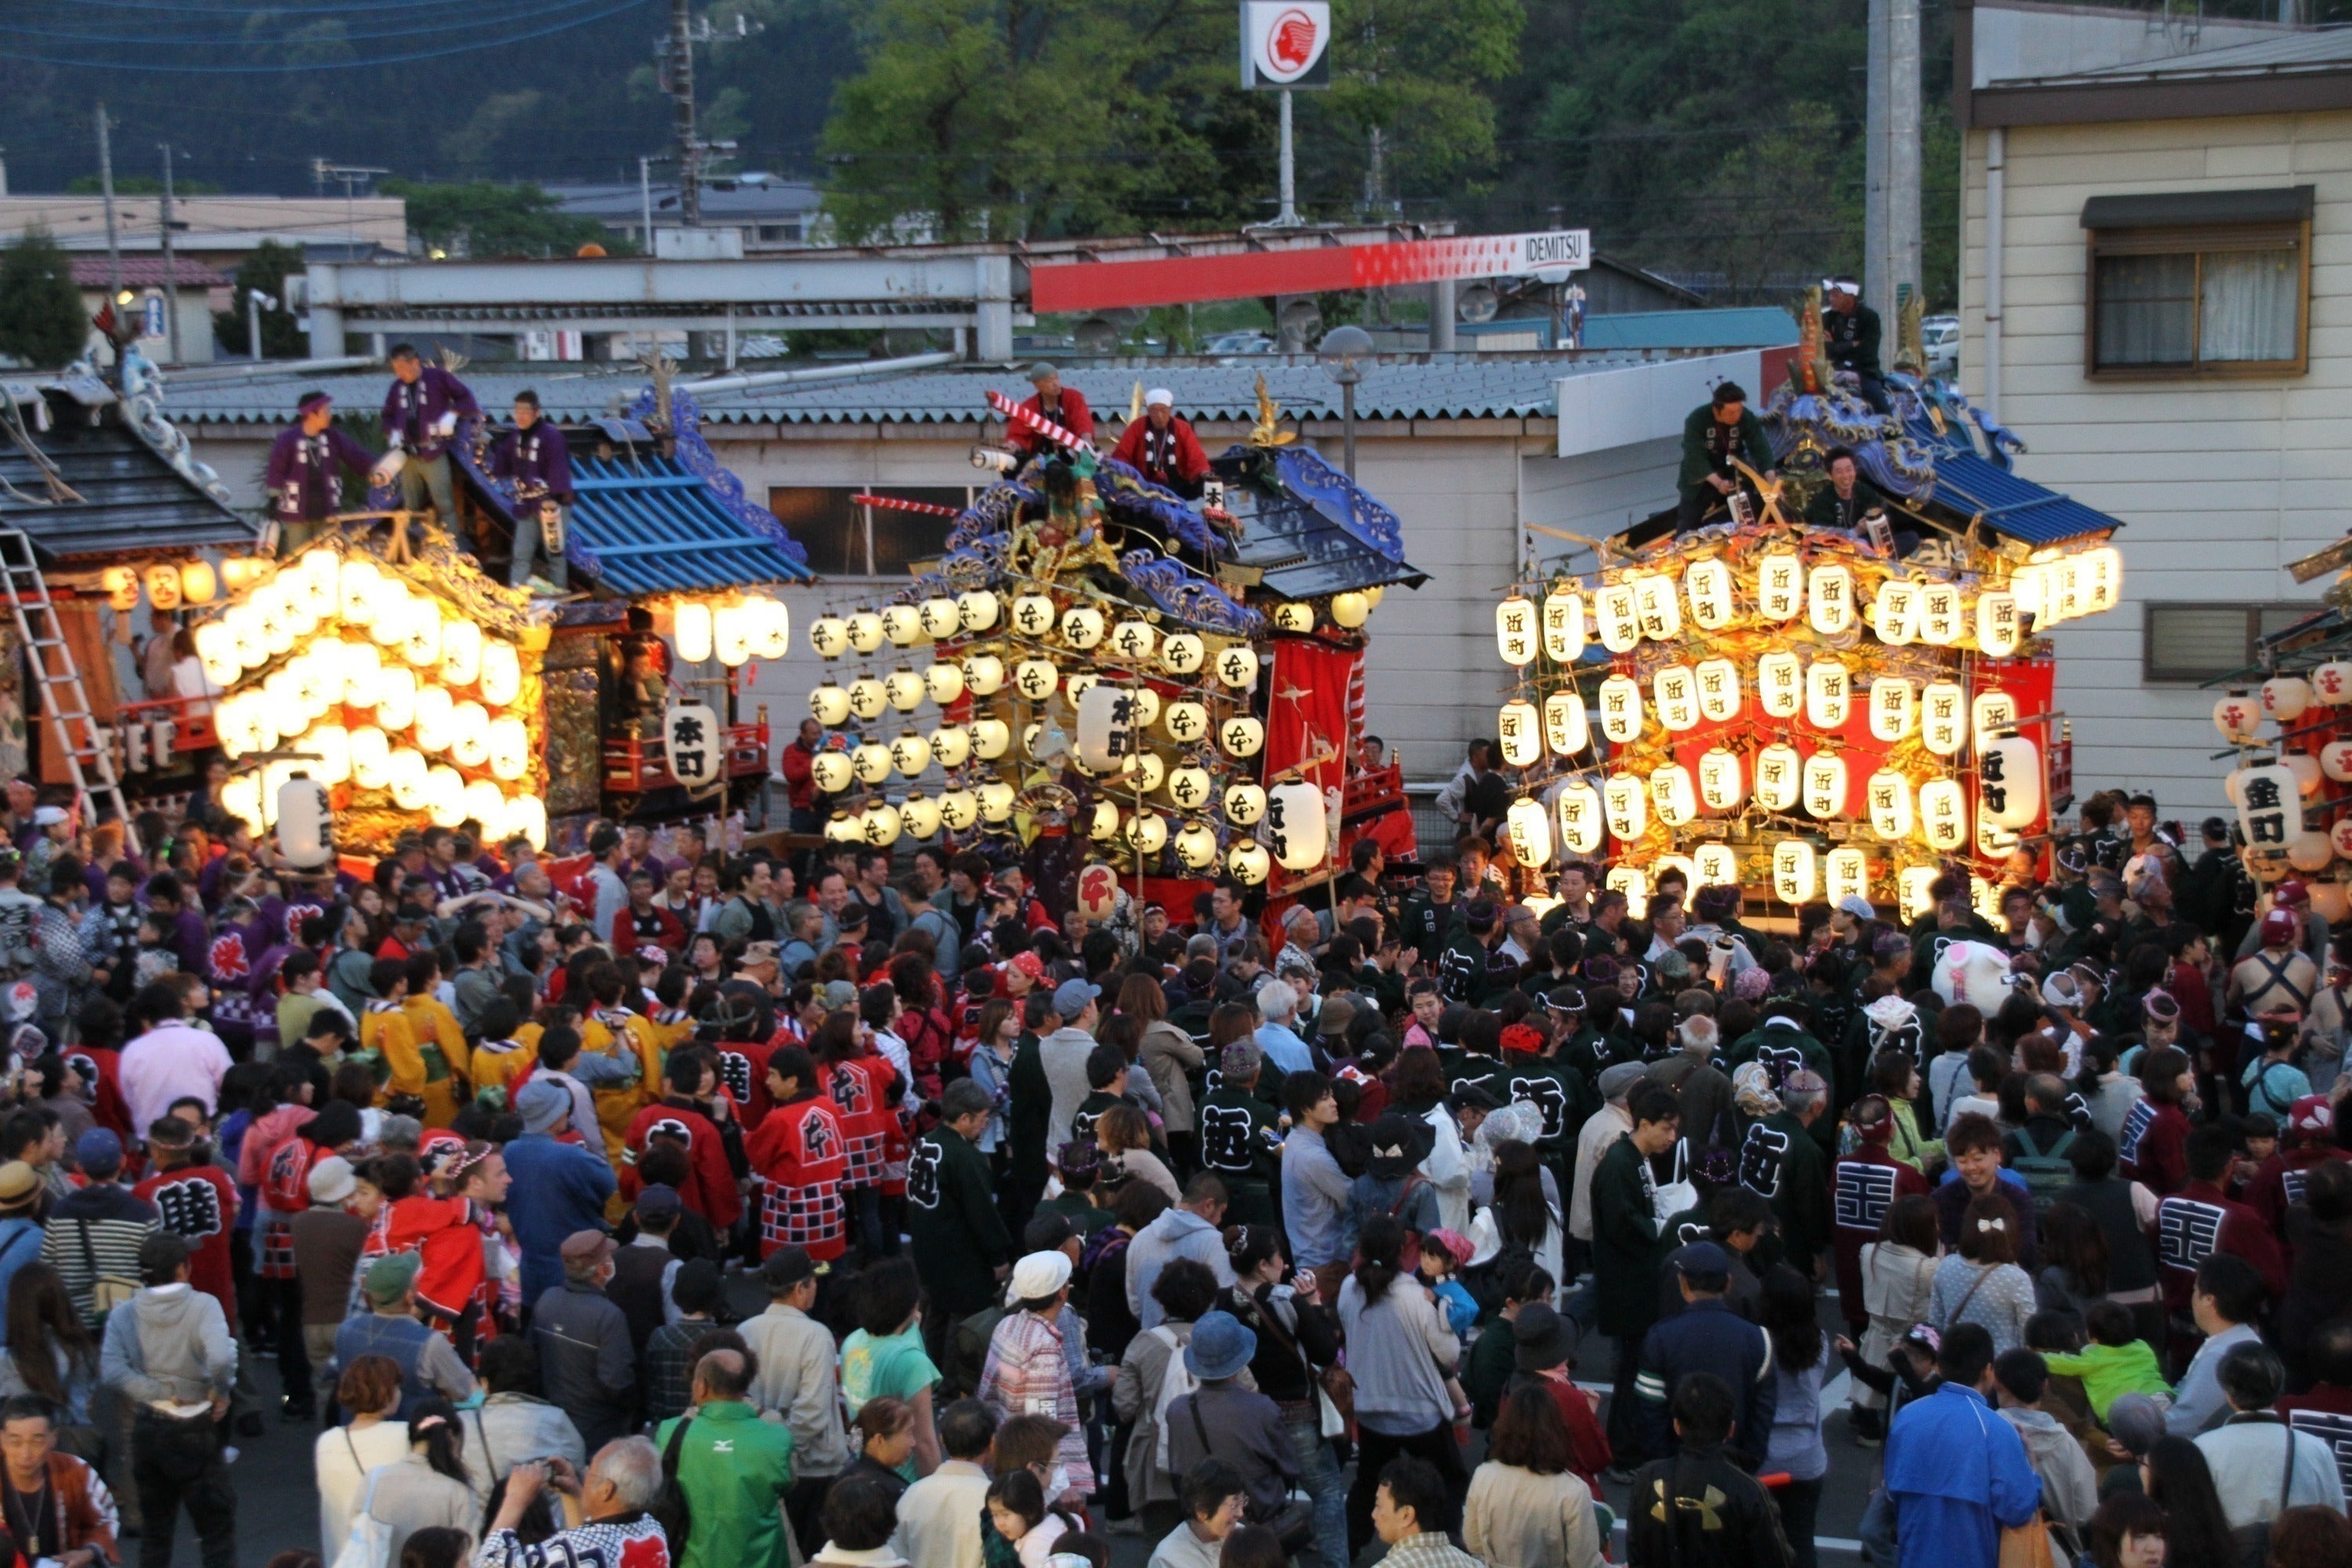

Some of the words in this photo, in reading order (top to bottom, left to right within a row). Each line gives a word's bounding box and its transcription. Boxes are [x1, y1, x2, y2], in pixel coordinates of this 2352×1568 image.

[1525, 234, 1581, 263] IDEMITSU
[1642, 590, 1664, 633] 近町
[1693, 575, 1715, 619] 近町
[1771, 568, 1790, 612] 近町
[1822, 580, 1842, 624] 近町
[1506, 612, 1524, 655] 近町
[1548, 608, 1566, 654] 近町
[1613, 596, 1635, 641] 近町
[1886, 595, 1907, 637] 近町
[1929, 595, 1950, 636] 近町
[1995, 604, 2014, 645] 近町
[1667, 679, 1689, 723] 近町
[1704, 673, 1725, 714] 近町
[1775, 666, 1794, 709] 近町
[1824, 676, 1842, 720] 近町
[1548, 707, 1566, 746] 近町
[1608, 694, 1627, 735] 近町
[1883, 690, 1904, 734] 近町
[1933, 698, 1953, 744] 近町
[673, 715, 706, 778] 本町
[1501, 717, 1519, 758] 近町
[1655, 782, 1677, 820] 近町
[1704, 768, 1722, 804] 近町
[1764, 764, 1782, 806] 近町
[1813, 771, 1832, 813] 近町
[1565, 803, 1582, 847] 近町
[1610, 793, 1631, 834] 近町
[1875, 789, 1896, 833] 近町
[1934, 795, 1955, 840] 近町
[1511, 820, 1530, 862] 近町
[1780, 855, 1798, 895] 近町
